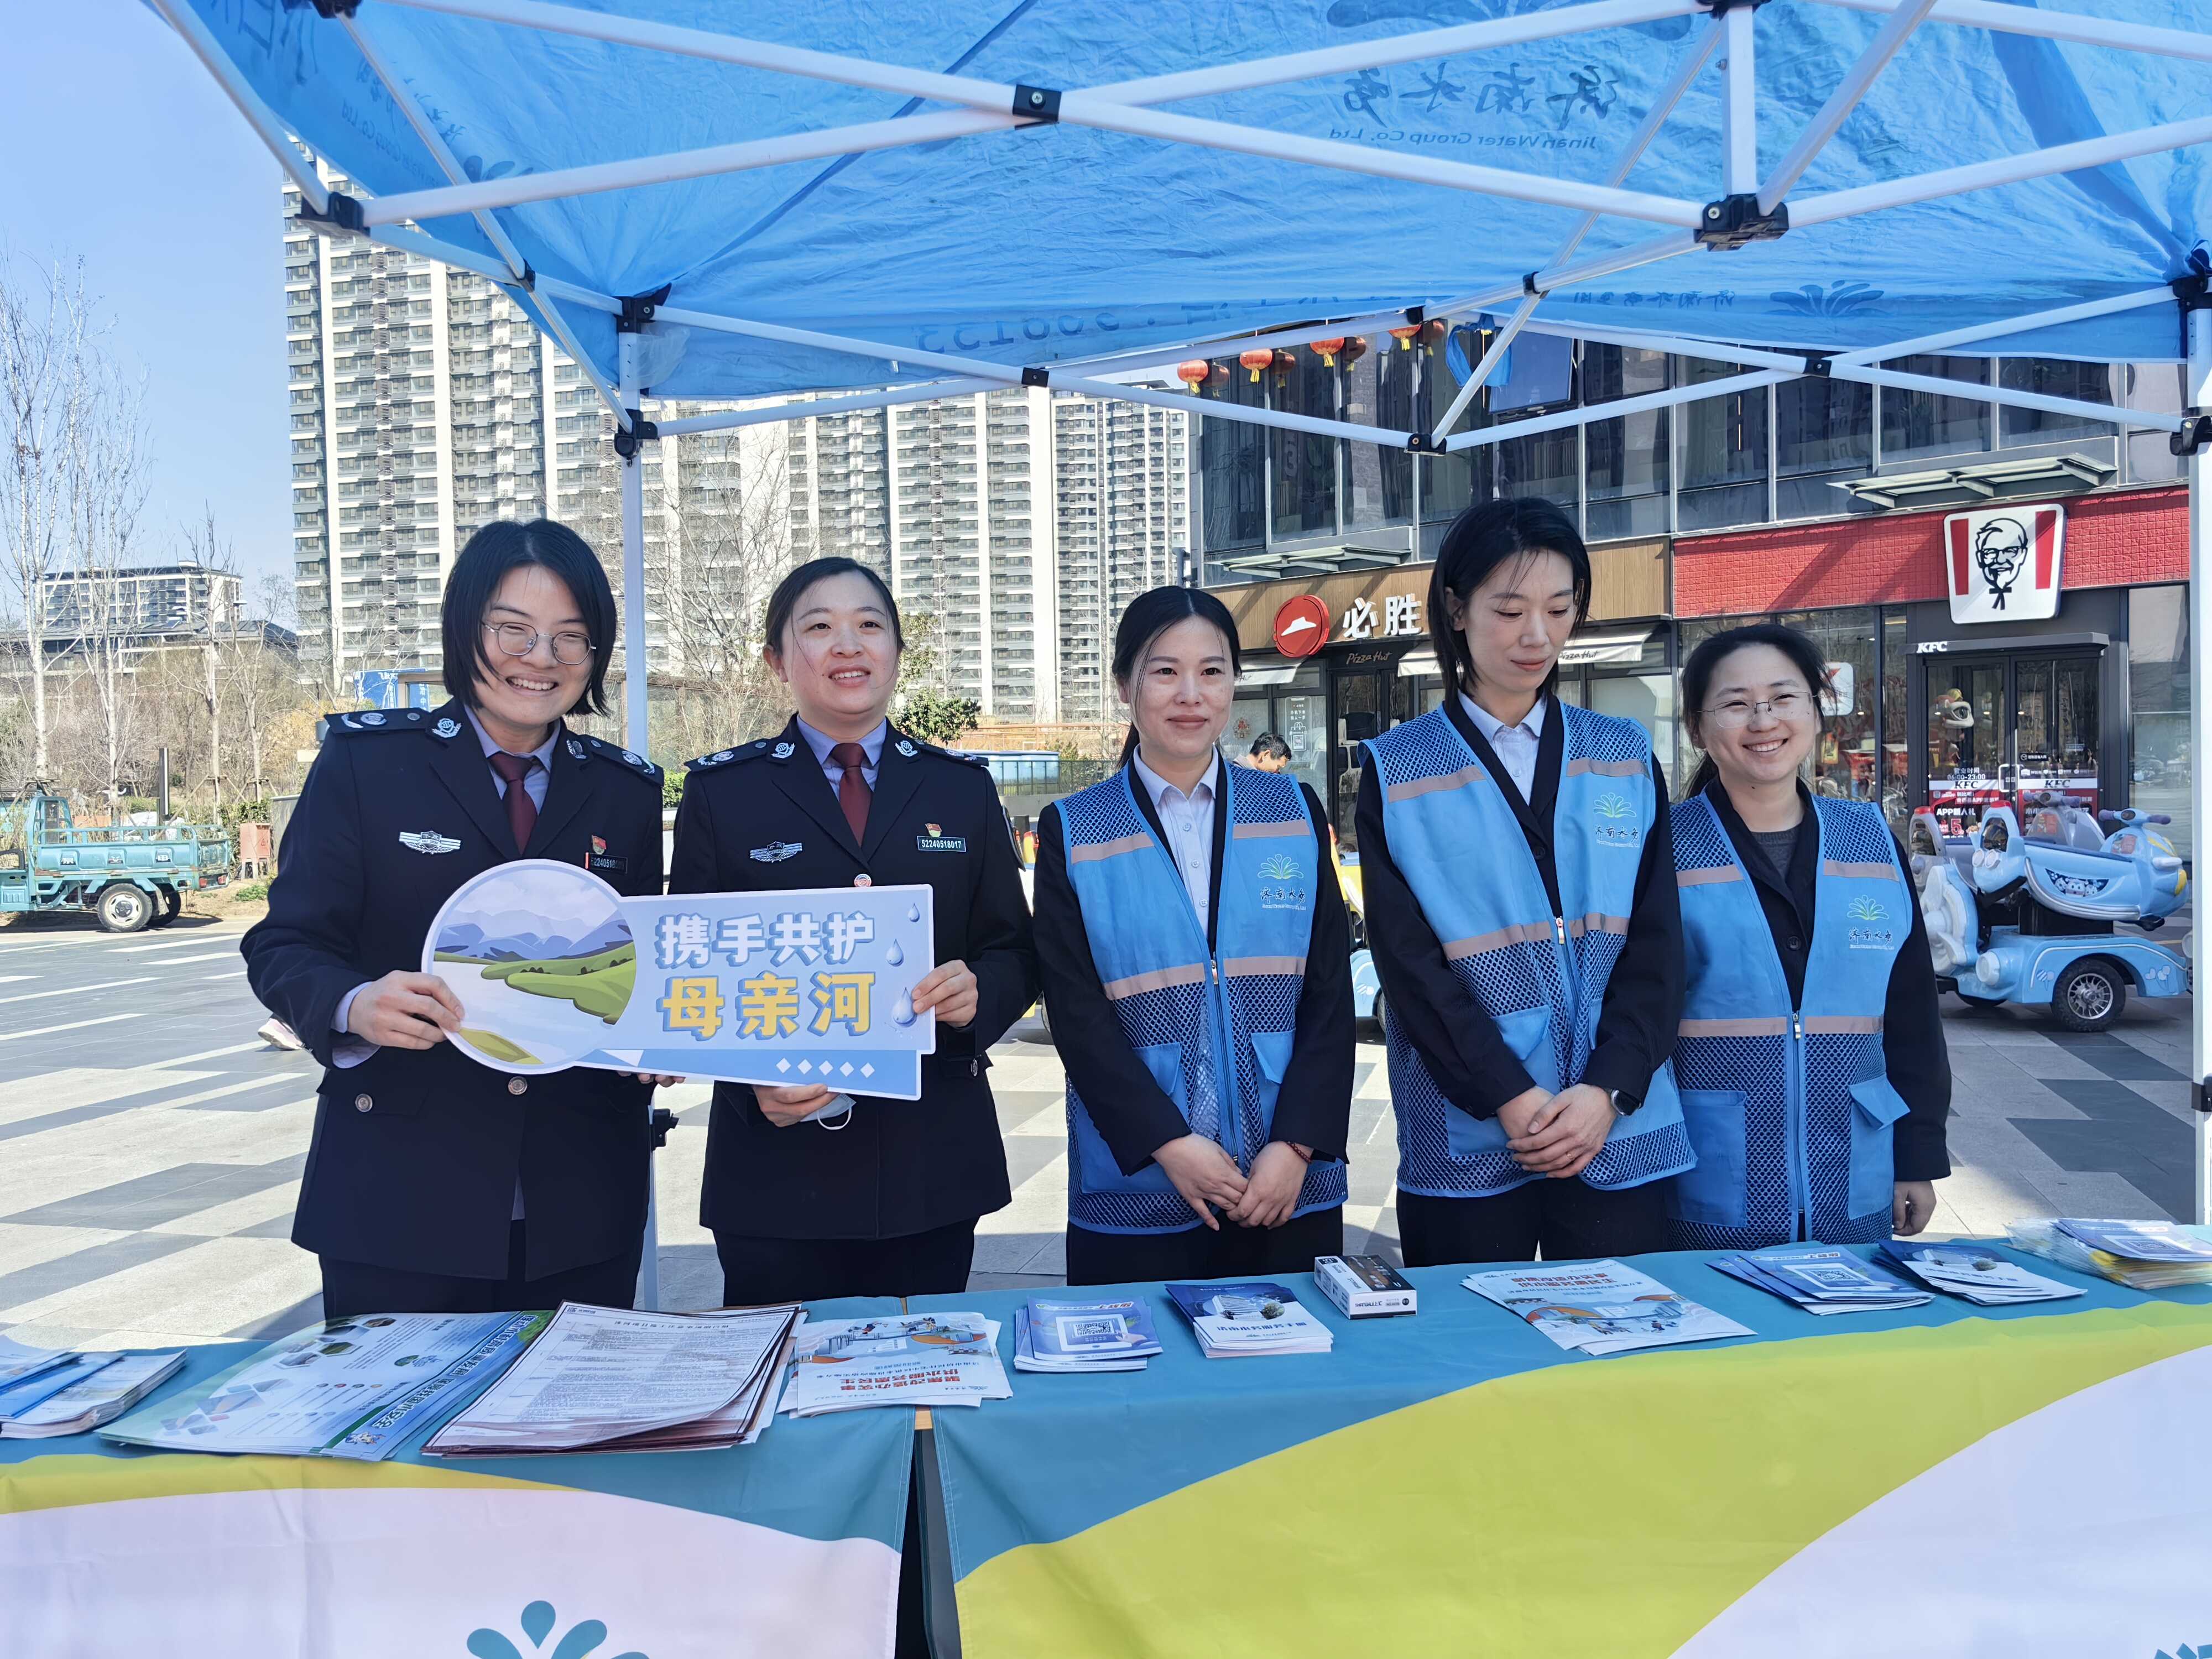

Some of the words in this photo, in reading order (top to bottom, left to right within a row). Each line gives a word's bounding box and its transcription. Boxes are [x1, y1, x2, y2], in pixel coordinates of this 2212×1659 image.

[1343, 593, 1422, 639] 必胜
[1581, 650, 1600, 659] Hut
[1917, 640, 1948, 653] KFC
[1346, 652, 1371, 665] Pizza
[1372, 651, 1392, 662] Hut
[1954, 780, 1978, 789] KFC
[2044, 779, 2070, 788] KFC
[1594, 825, 1639, 844] 济南水务
[921, 839, 962, 849] 52240518017
[1260, 886, 1306, 905] 济南水务
[655, 912, 876, 969] 携手共护
[1849, 926, 1893, 946] 济南水务
[661, 970, 876, 1041] 母亲河
